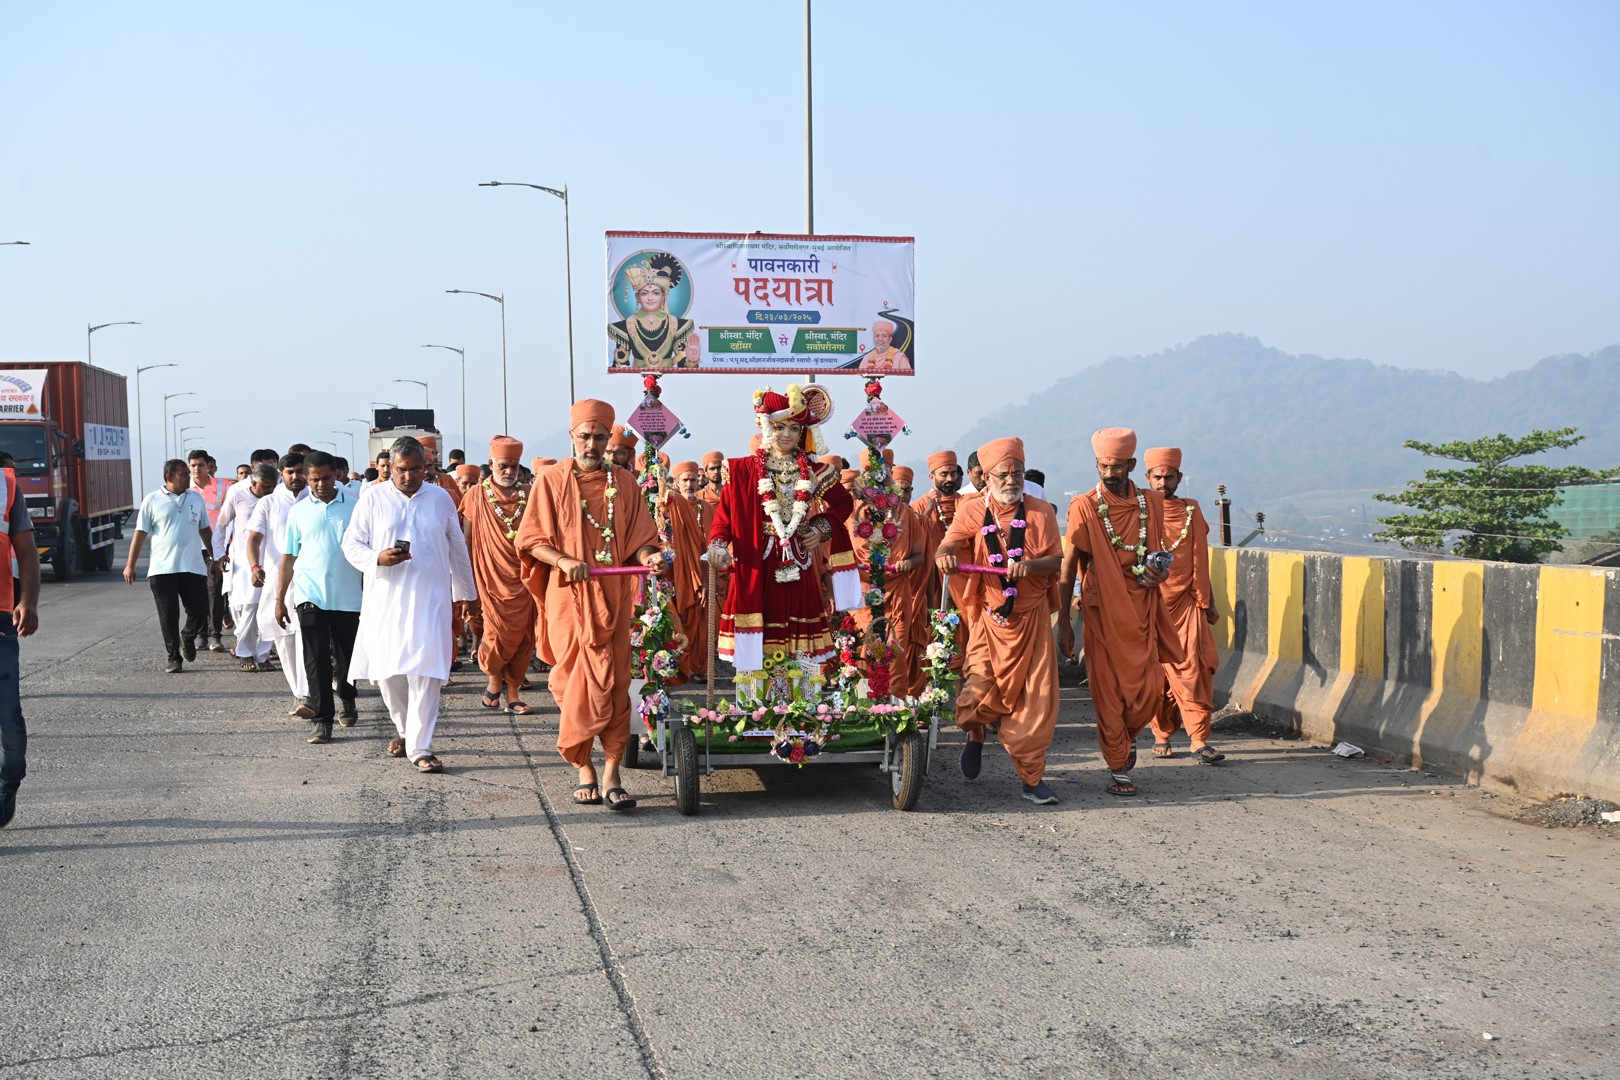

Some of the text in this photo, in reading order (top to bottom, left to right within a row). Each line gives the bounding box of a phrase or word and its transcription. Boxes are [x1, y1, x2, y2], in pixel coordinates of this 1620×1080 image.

[747, 254, 821, 273] पावनकारी
[733, 277, 835, 307] पदयात्रा
[755, 311, 812, 322] दि.२३/०३/२०२५
[719, 330, 763, 340] श्रीस्वा. मंदिर
[778, 333, 789, 346] से
[805, 331, 847, 341] श्रीस्वा. मंदिर
[805, 341, 846, 351] सर्वोपरीनगर
[0, 404, 25, 413] ARRIER
